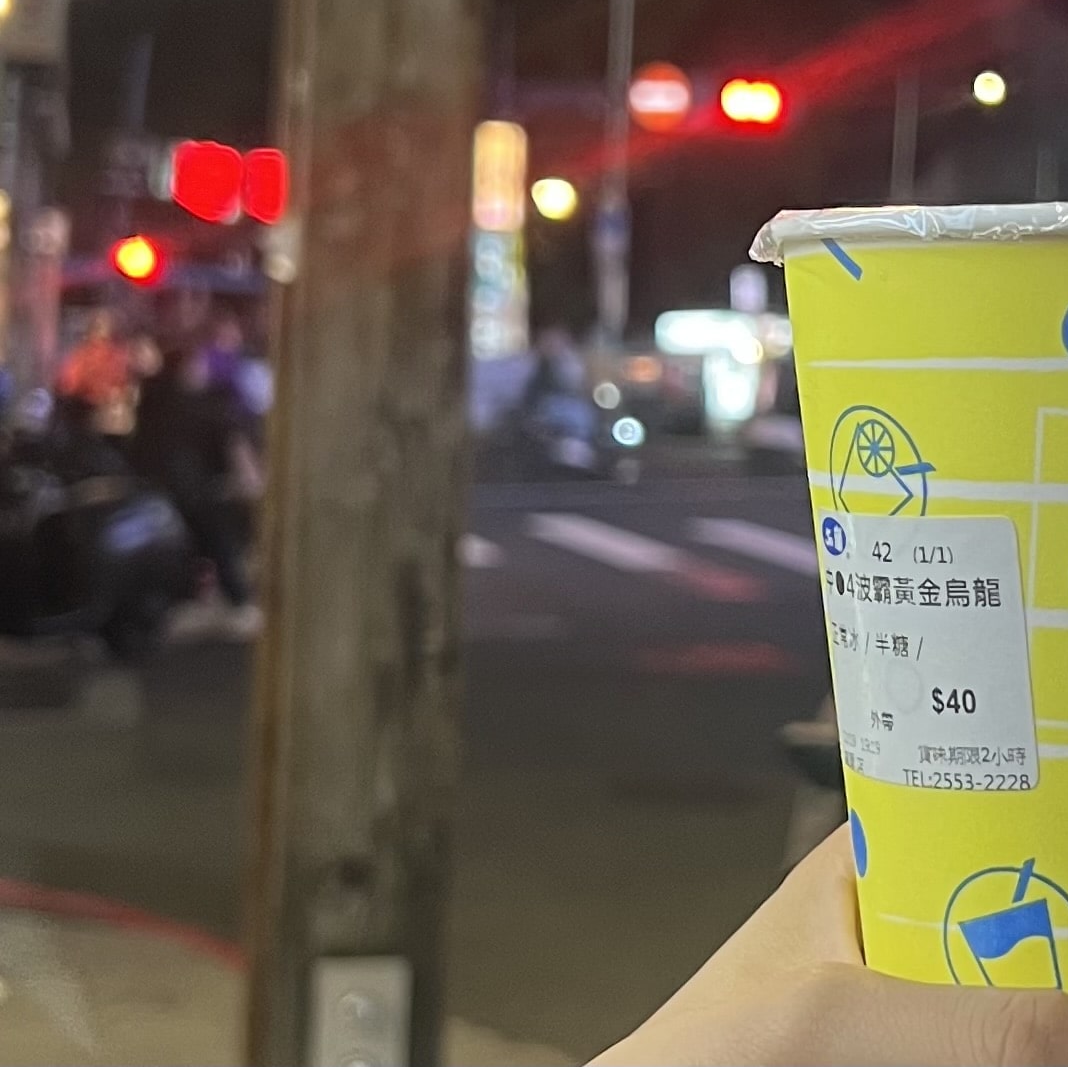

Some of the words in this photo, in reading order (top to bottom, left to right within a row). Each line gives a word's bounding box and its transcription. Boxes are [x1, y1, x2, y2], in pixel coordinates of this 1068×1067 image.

[872, 540, 893, 563] 42
[913, 545, 954, 564] (1/1)
[875, 633, 909, 657] 半糖
[931, 687, 977, 714] $40
[902, 768, 1032, 791] TEL:2553-2228
